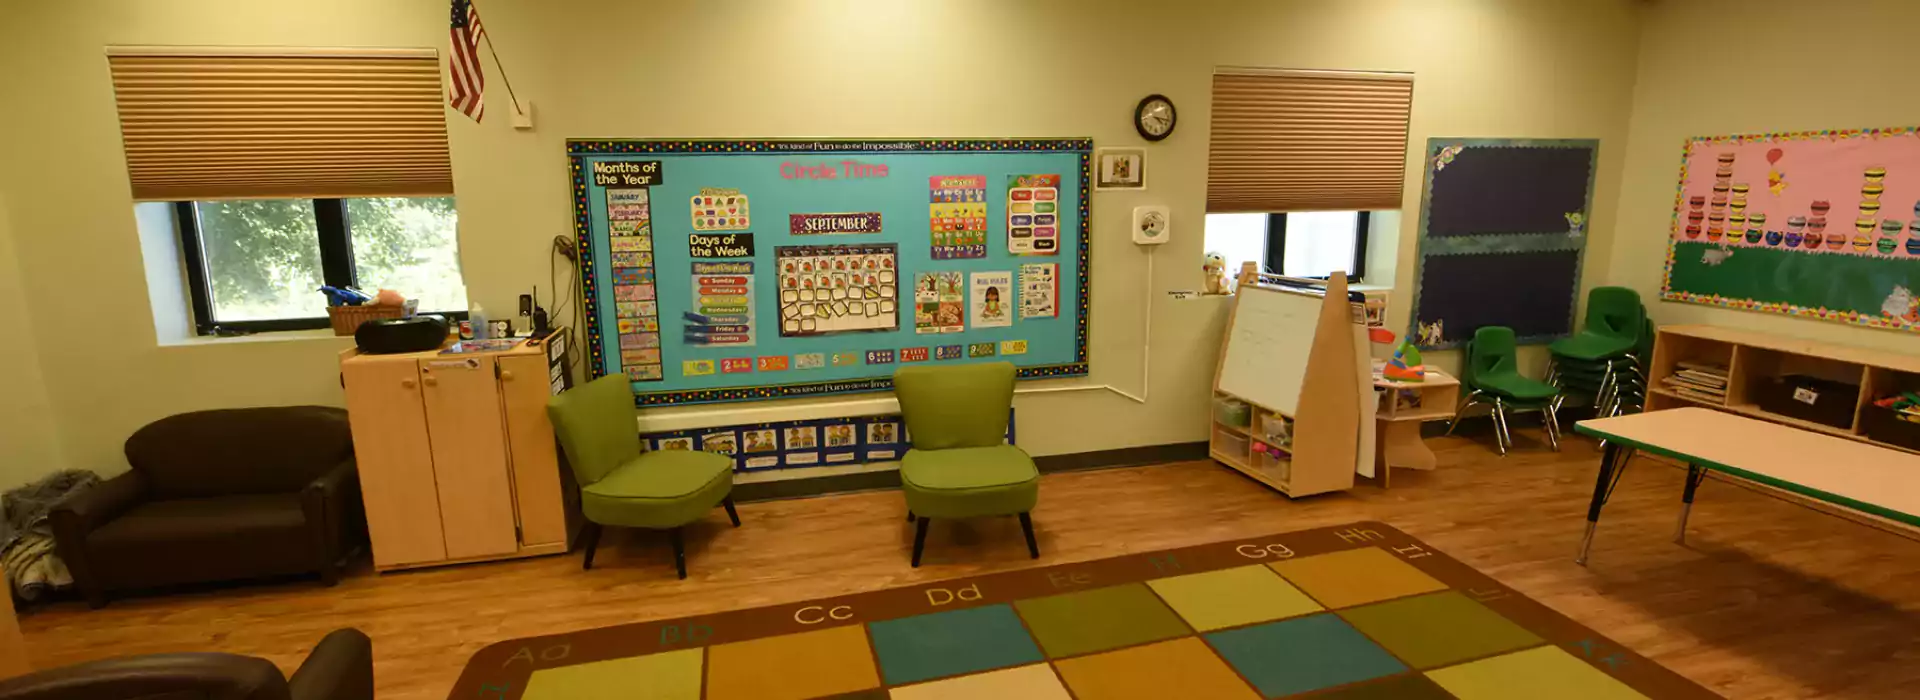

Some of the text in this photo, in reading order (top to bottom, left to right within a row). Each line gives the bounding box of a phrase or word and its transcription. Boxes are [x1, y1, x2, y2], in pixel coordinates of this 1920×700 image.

[814, 142, 834, 151] Fun
[594, 162, 657, 174] Months of
[780, 160, 889, 179] Circle Time
[596, 173, 652, 185] the Year
[804, 217, 867, 230] SEPTEMBER
[689, 234, 736, 247] Days of
[691, 246, 748, 257] the Week
[902, 350, 909, 359] 7
[936, 346, 943, 356] 8
[971, 345, 977, 354] 9
[760, 358, 767, 367] 3
[832, 353, 839, 363] 5
[868, 352, 875, 361] 6
[724, 361, 731, 369] 2
[1334, 527, 1385, 544] Hh
[1236, 543, 1295, 559] Gg
[1047, 571, 1092, 589] Ee
[925, 583, 983, 606] Dd
[794, 605, 854, 625] Cc
[659, 621, 713, 645] Bb
[502, 643, 571, 668] Aa
